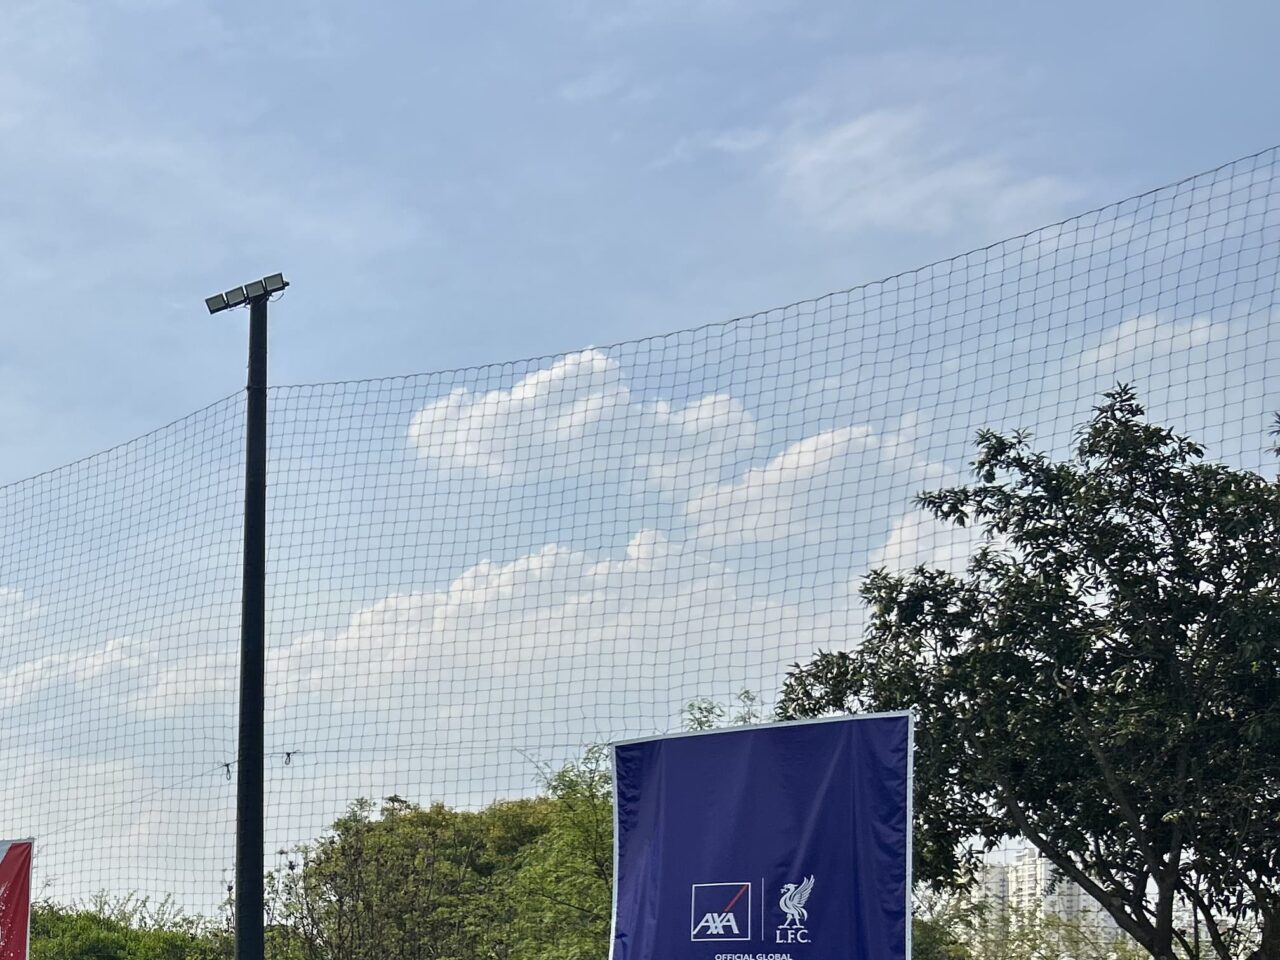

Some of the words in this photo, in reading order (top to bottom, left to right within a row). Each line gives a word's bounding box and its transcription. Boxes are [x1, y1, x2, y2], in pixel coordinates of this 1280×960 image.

[692, 912, 740, 935] AXA
[714, 953, 755, 960] OFFICIAL
[756, 953, 793, 960] GLOBAL
